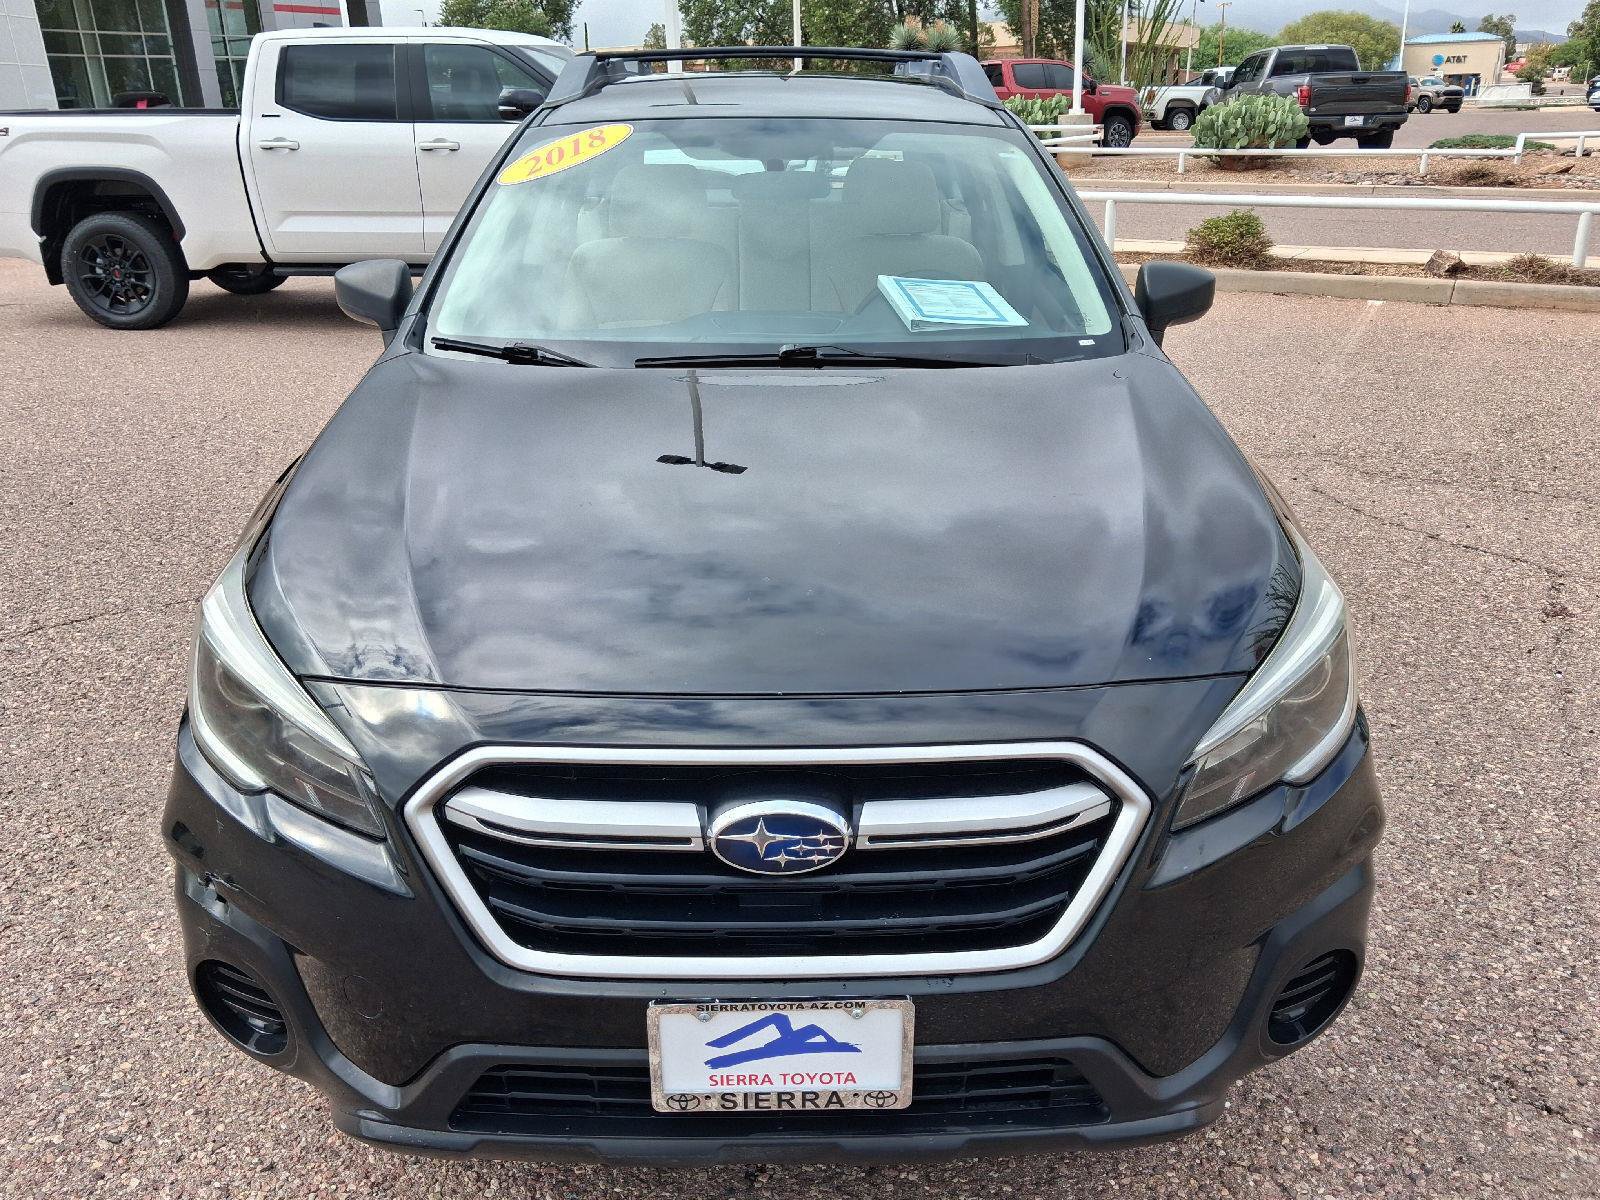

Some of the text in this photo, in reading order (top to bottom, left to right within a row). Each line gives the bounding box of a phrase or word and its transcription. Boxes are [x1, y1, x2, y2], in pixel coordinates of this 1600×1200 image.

[1445, 55, 1467, 64] AT&T
[524, 128, 606, 177] 2018
[696, 1001, 866, 1012] SIERRATOYOTA-AZ.COM
[709, 1072, 857, 1087] SIERRA TOYOTA
[720, 1090, 845, 1110] SIERRA
